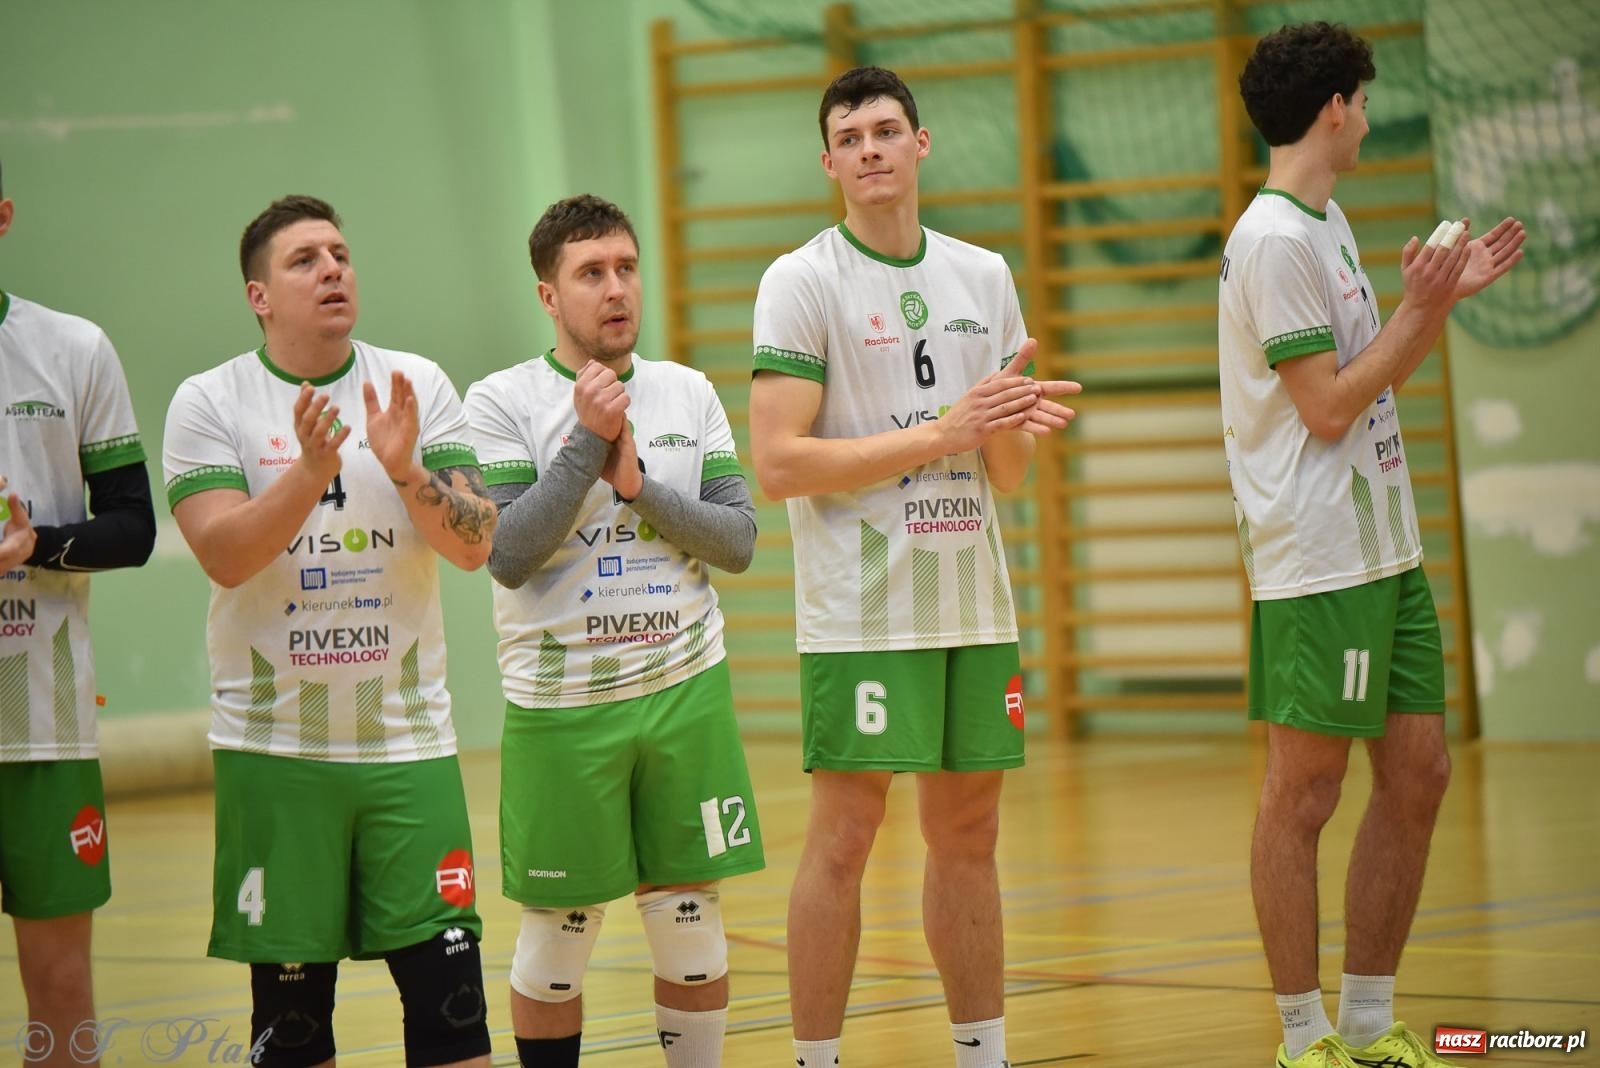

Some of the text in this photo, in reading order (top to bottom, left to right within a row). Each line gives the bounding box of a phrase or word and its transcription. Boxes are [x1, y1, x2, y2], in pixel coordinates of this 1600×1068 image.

[944, 324, 989, 335] AGROTEAM
[912, 338, 936, 390] 6
[890, 405, 952, 430] VIS
[259, 456, 297, 467] Racibó
[319, 473, 347, 511] 4
[904, 497, 982, 521] PIVEXIN
[576, 521, 664, 547] VISO
[905, 519, 982, 535] TECHNOLOGY
[287, 527, 394, 556] VISON
[598, 581, 681, 598] kierunekbmp.pl
[301, 593, 393, 612] kierunekbmp.pl
[586, 610, 679, 635] PIVEXIN
[289, 624, 389, 651] PIVEXIN
[289, 647, 389, 666] TECHNOLOGY
[1342, 648, 1370, 702] 11
[854, 680, 888, 736] 6
[700, 795, 751, 858] 12
[237, 867, 266, 926] 4
